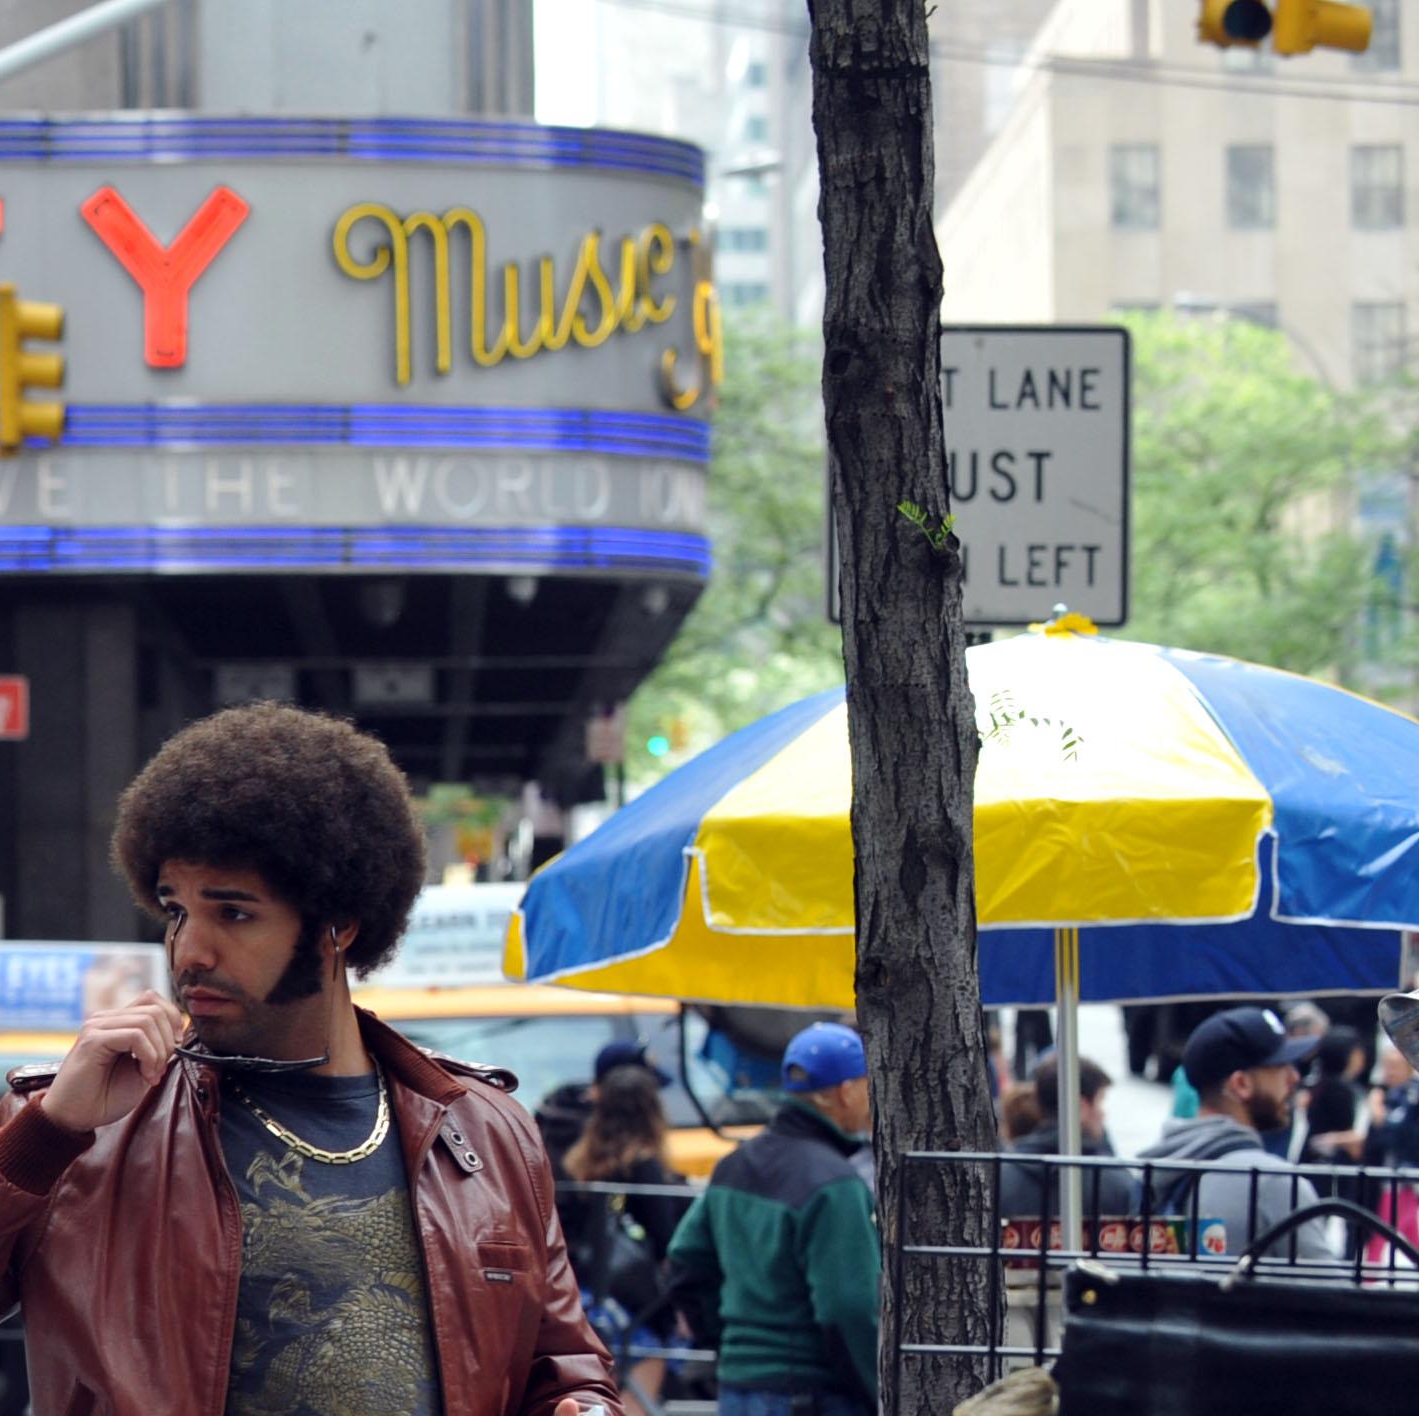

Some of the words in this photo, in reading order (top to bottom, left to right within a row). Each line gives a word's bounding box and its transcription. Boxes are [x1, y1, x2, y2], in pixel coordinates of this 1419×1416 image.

[333, 203, 676, 384] Music
[988, 366, 1102, 411] LANE
[160, 453, 304, 518] THE
[372, 454, 611, 521] WORLD
[950, 450, 1053, 502] UST
[999, 545, 1102, 587] LEFT
